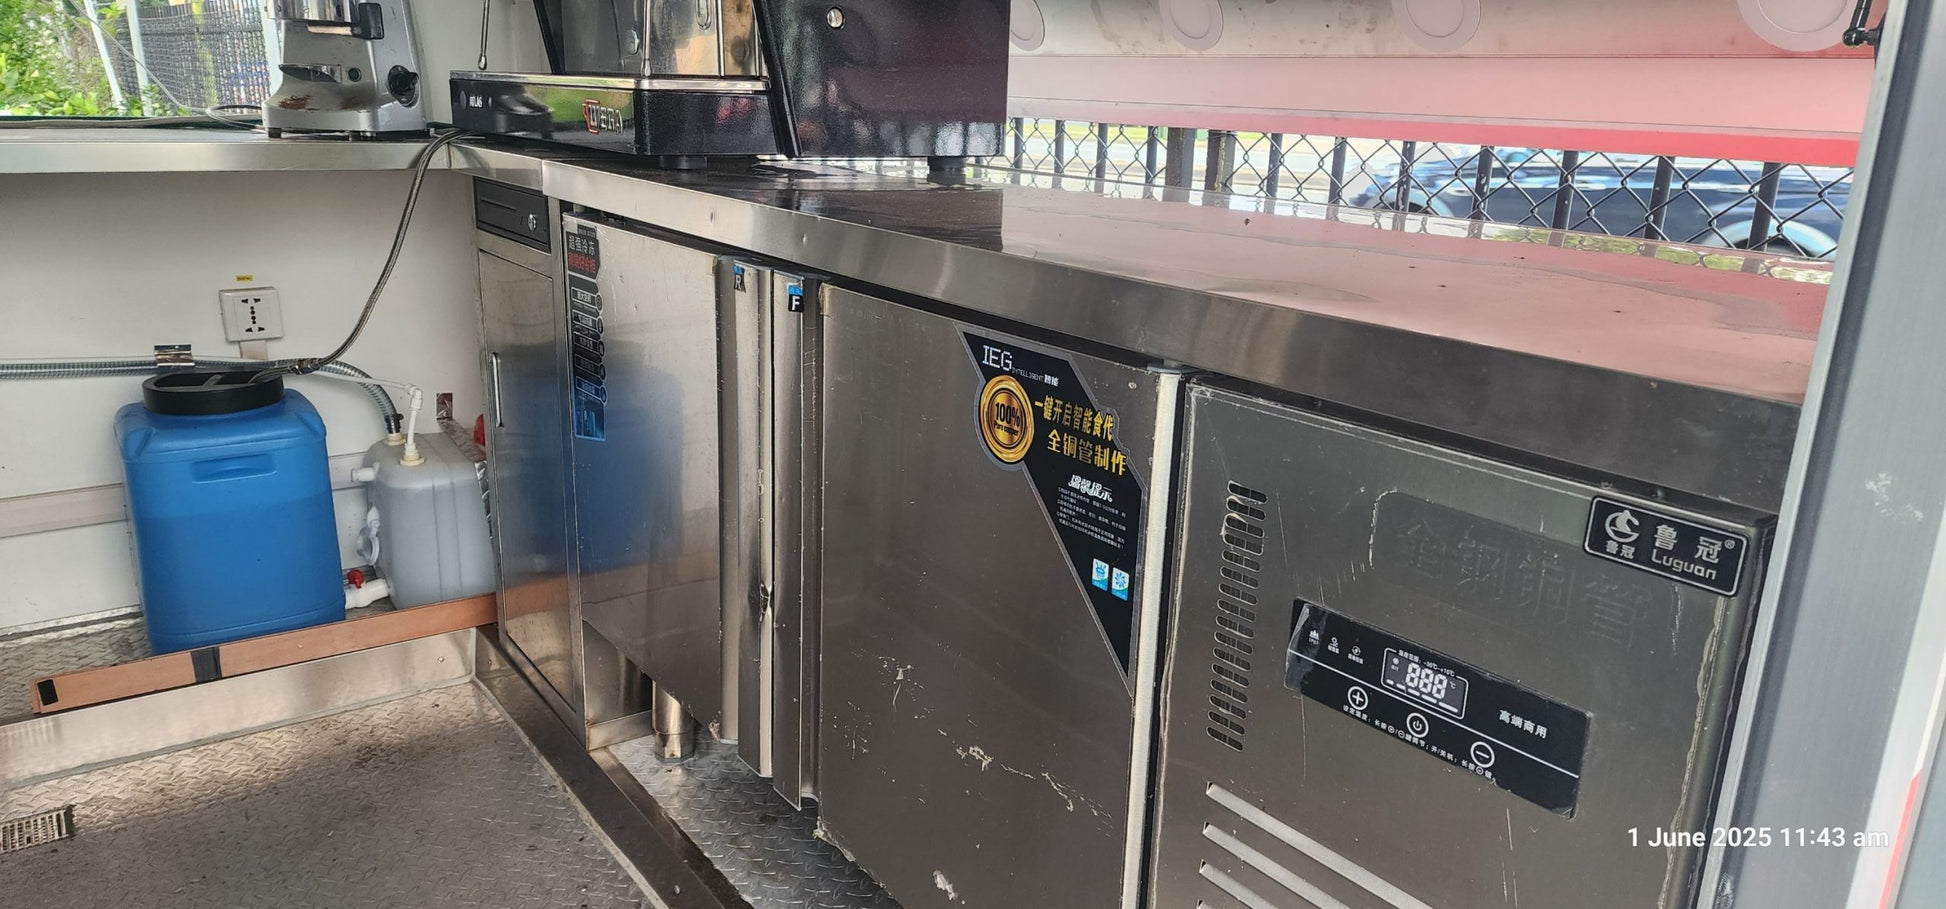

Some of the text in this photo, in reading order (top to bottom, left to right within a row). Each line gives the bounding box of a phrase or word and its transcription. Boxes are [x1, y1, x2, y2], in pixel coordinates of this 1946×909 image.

[735, 275, 742, 290] R
[792, 295, 800, 311] F
[982, 345, 1012, 371] IEG
[995, 402, 1020, 427] 100%
[1034, 395, 1114, 441] 一键开启智能食代
[1047, 429, 1126, 476] 全铜管制作
[1605, 540, 1636, 559] 鲁冠
[1651, 548, 1717, 580] Luguan
[1405, 662, 1448, 699] 888
[1499, 709, 1548, 739] 高端商用
